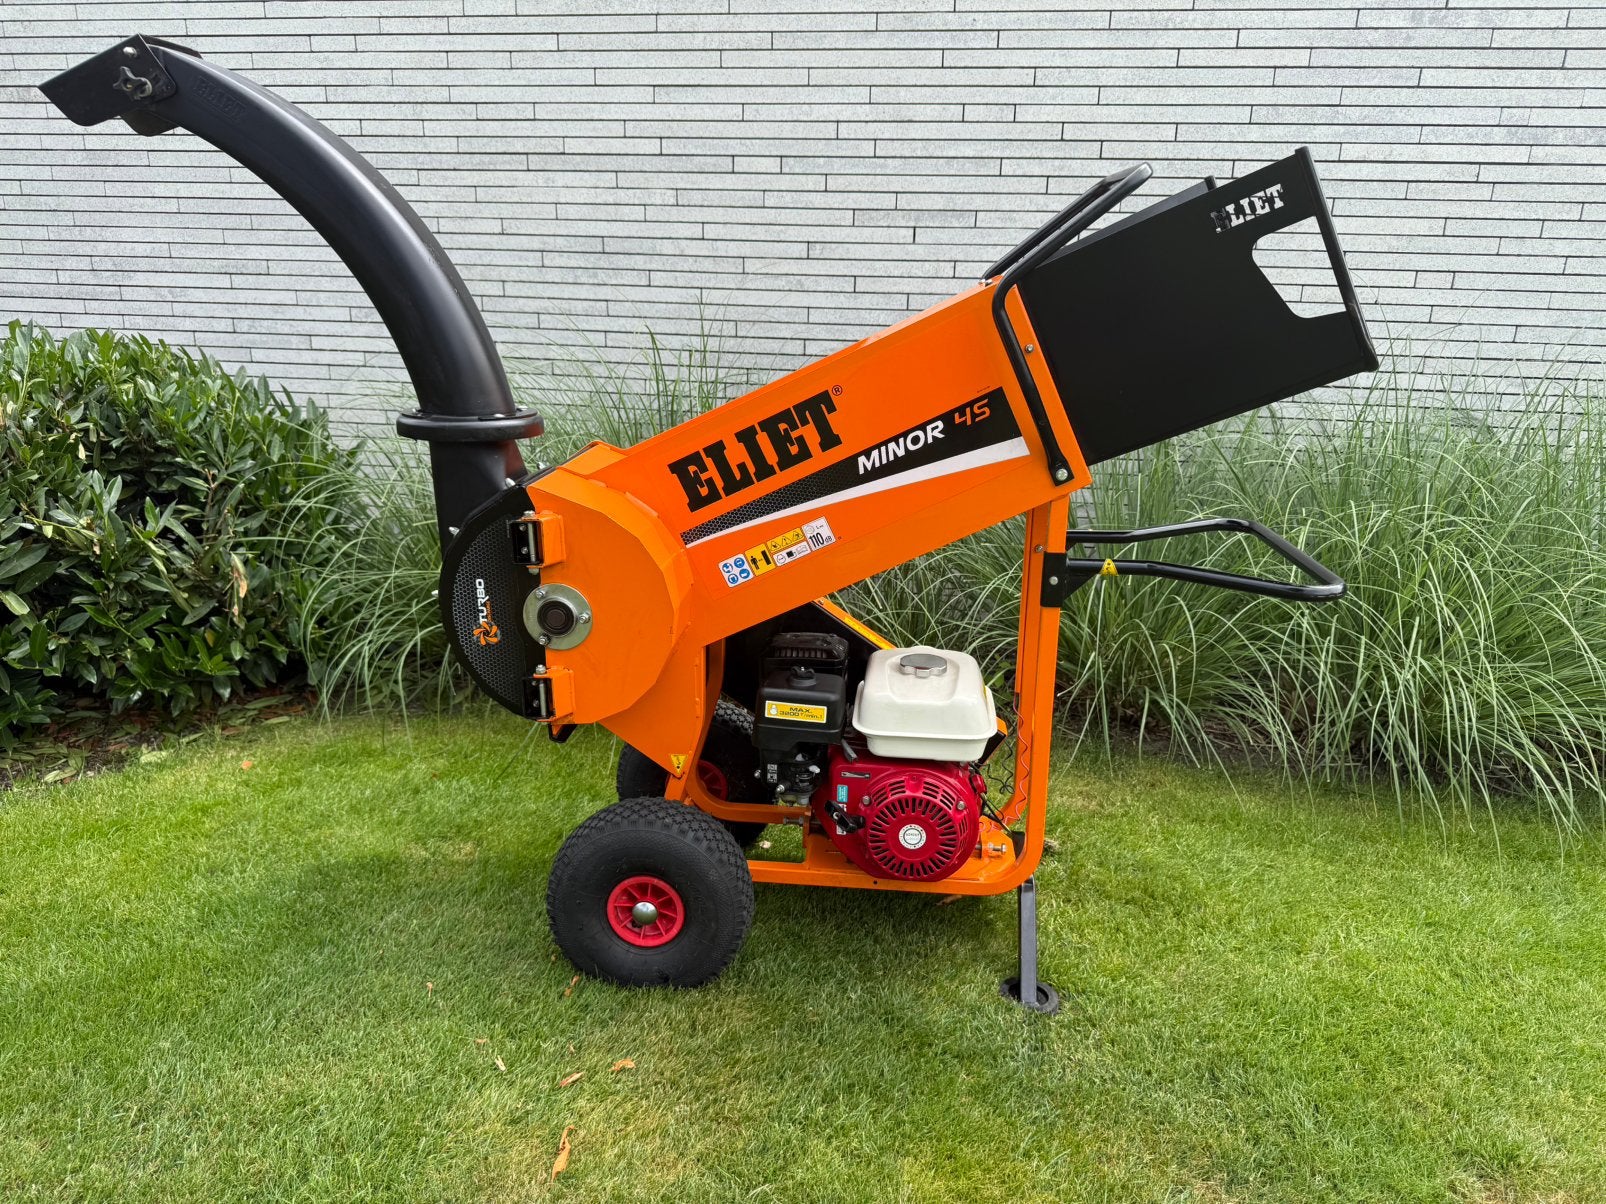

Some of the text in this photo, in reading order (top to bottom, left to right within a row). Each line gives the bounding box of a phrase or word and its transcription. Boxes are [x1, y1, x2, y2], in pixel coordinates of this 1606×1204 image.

[857, 420, 946, 475] MINOR
[808, 532, 825, 548] 110
[475, 578, 489, 624] TURBO
